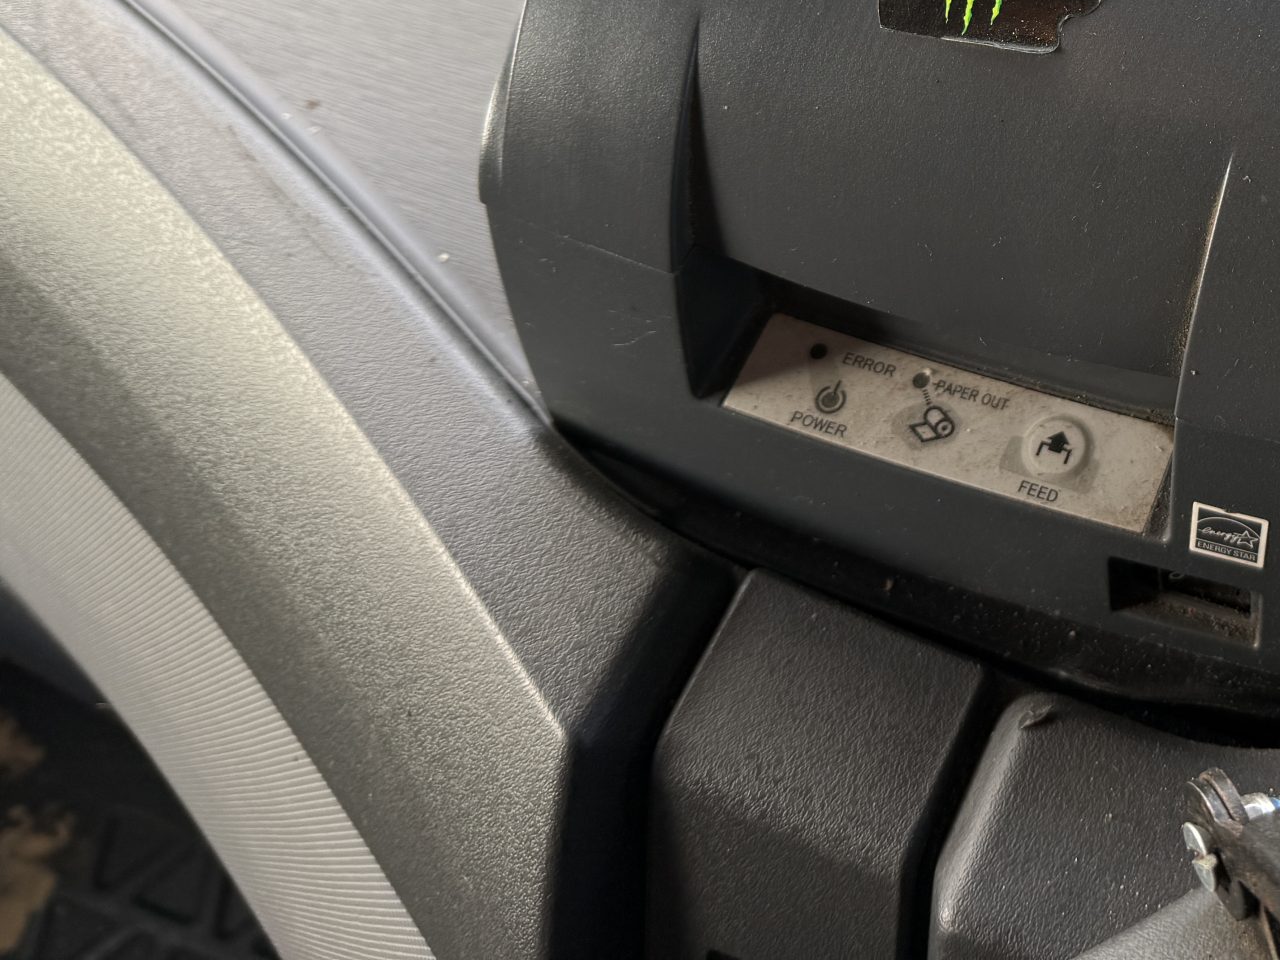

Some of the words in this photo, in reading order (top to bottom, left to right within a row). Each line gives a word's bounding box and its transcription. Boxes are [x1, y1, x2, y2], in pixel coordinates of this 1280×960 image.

[842, 351, 897, 377] ERROR
[934, 379, 980, 403] PAPER
[981, 392, 1011, 411] OUT
[790, 410, 848, 438] POWER
[1017, 479, 1059, 503] FEED
[1197, 540, 1232, 555] ENERGY
[1232, 549, 1257, 561] STAR
